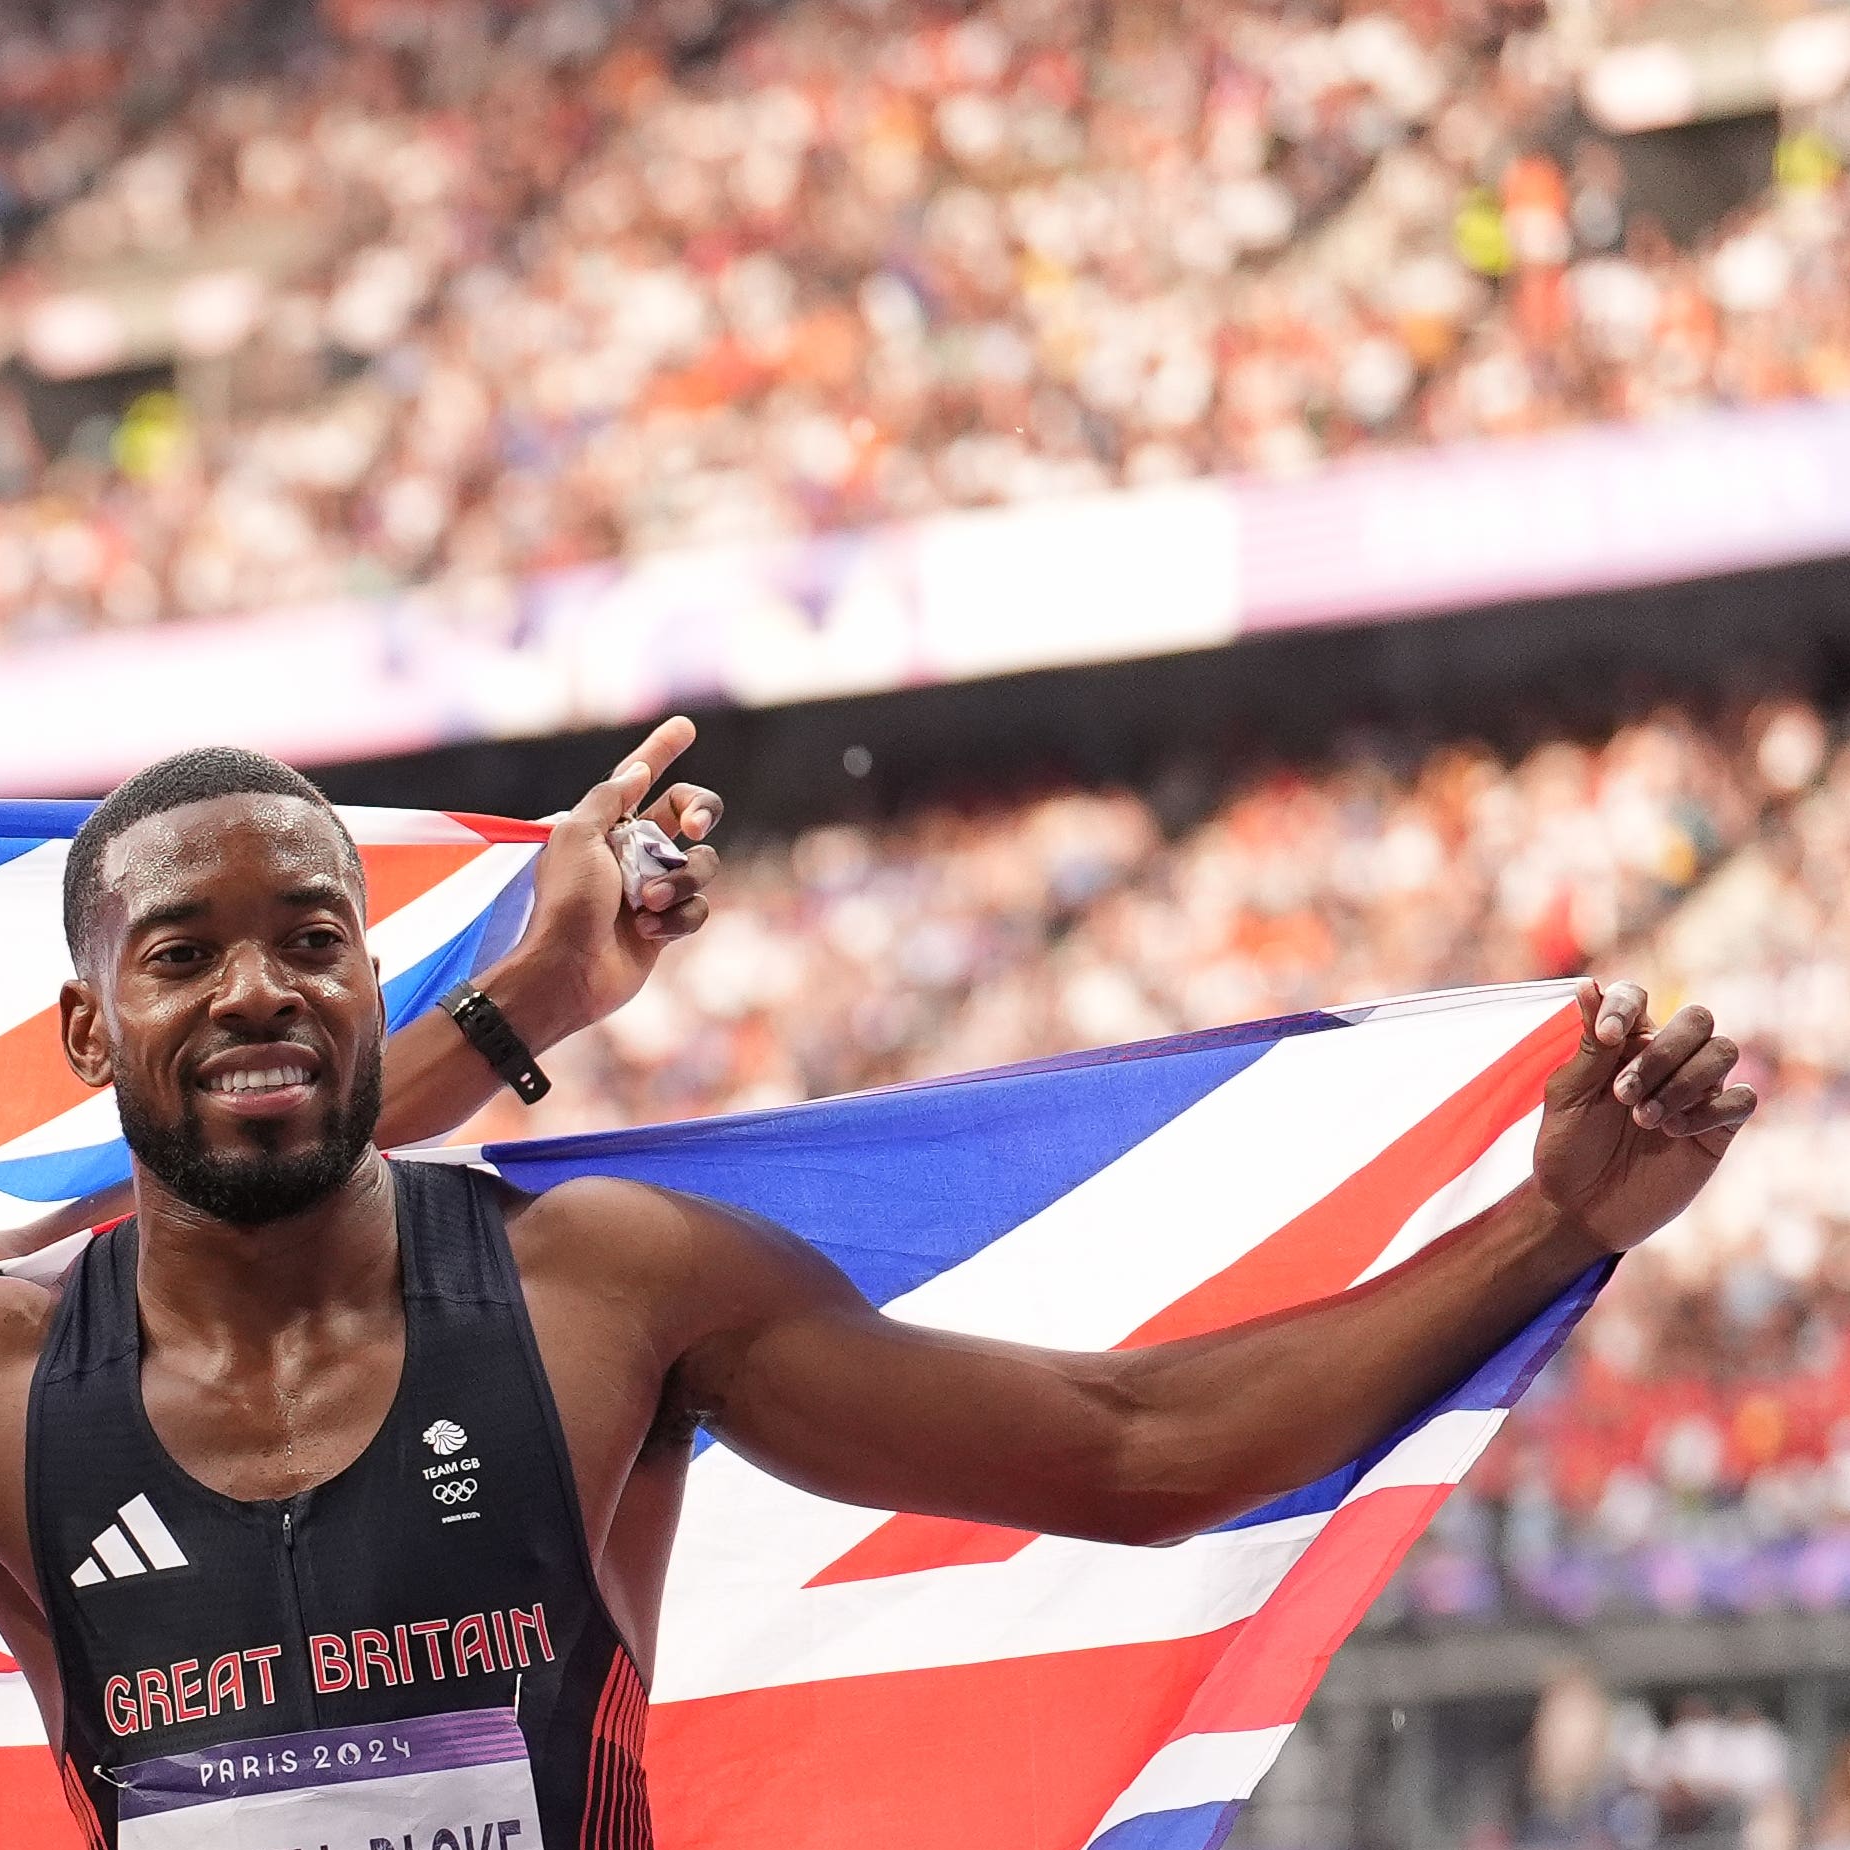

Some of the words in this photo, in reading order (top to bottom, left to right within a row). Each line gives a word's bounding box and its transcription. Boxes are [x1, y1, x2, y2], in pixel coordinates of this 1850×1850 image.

[422, 1461, 459, 1480] TEAM
[460, 1457, 481, 1471] GB
[104, 1643, 282, 1737] GREAT
[309, 1602, 556, 1695] BRITAIN
[200, 1748, 299, 1787] PARIS
[313, 1736, 413, 1770] 2024
